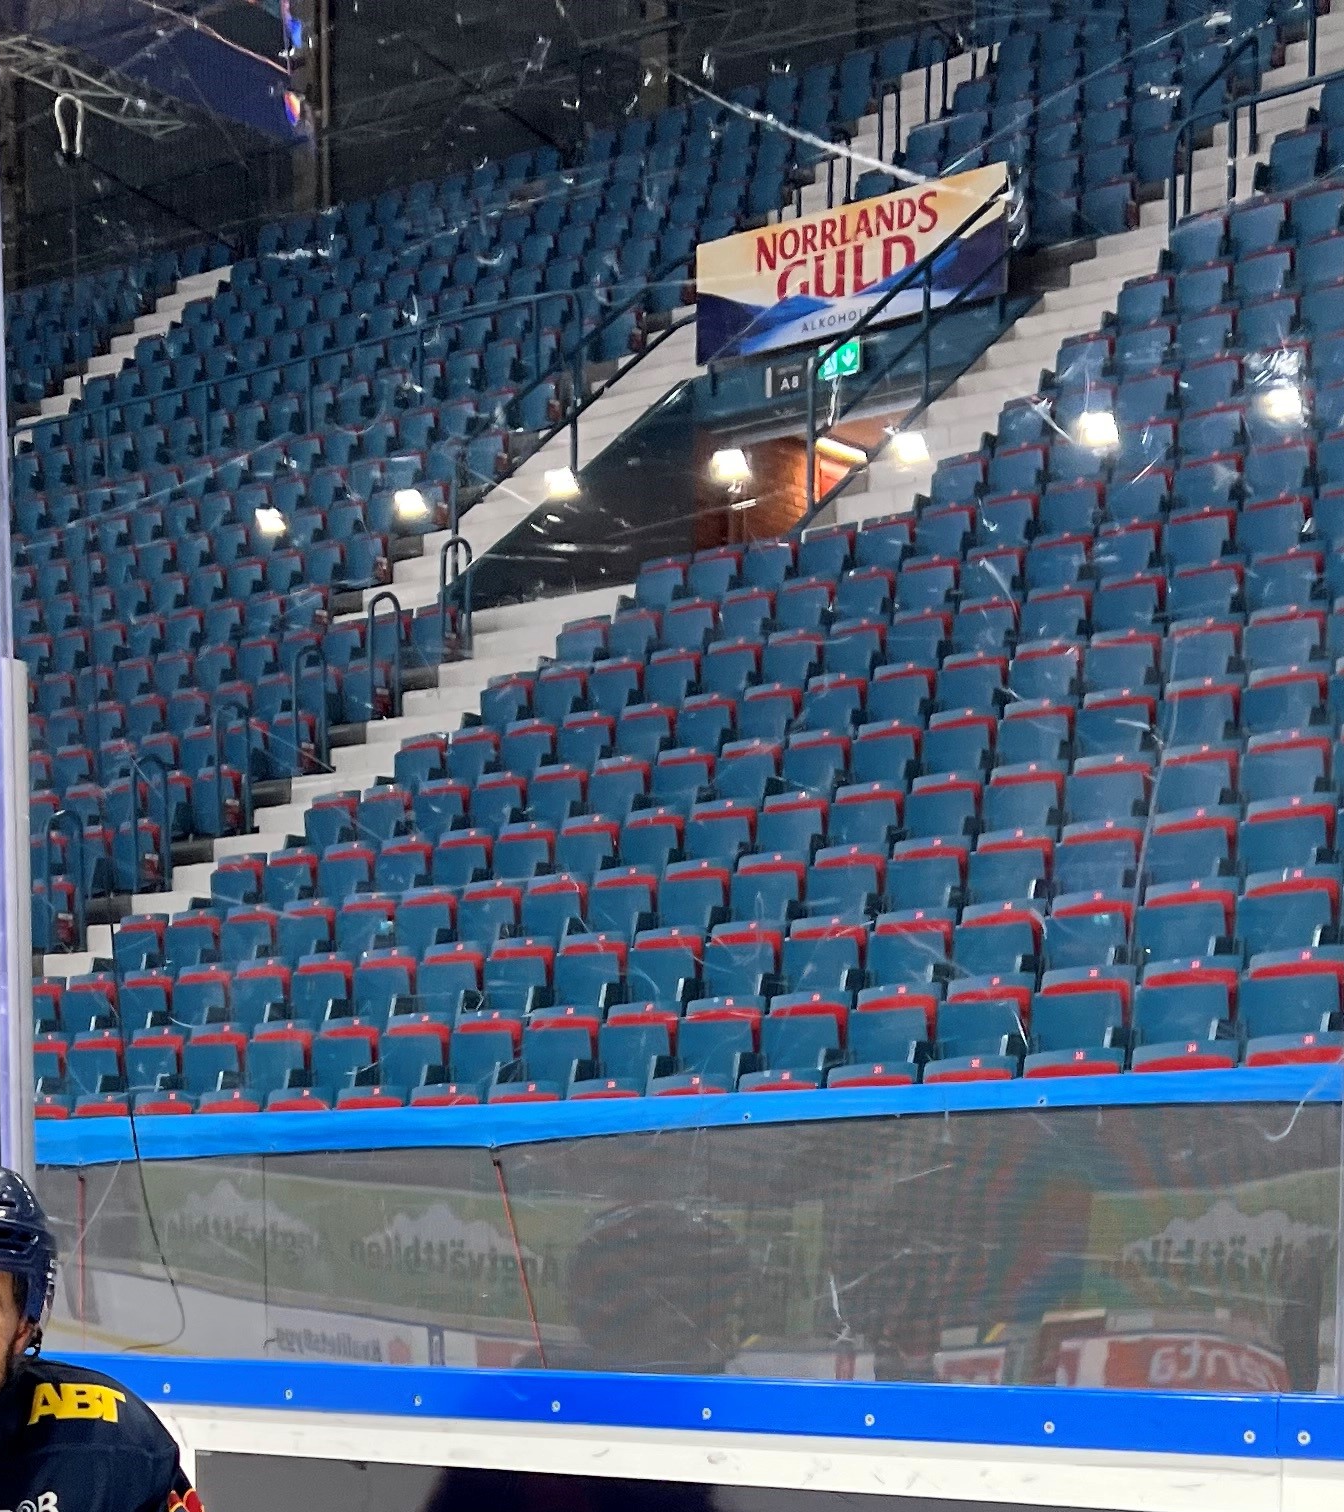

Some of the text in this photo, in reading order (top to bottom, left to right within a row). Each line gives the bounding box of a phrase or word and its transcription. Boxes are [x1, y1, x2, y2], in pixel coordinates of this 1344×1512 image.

[756, 190, 938, 273] NORRLANDS
[777, 234, 916, 300] GULD
[27, 1382, 126, 1426] ABT
